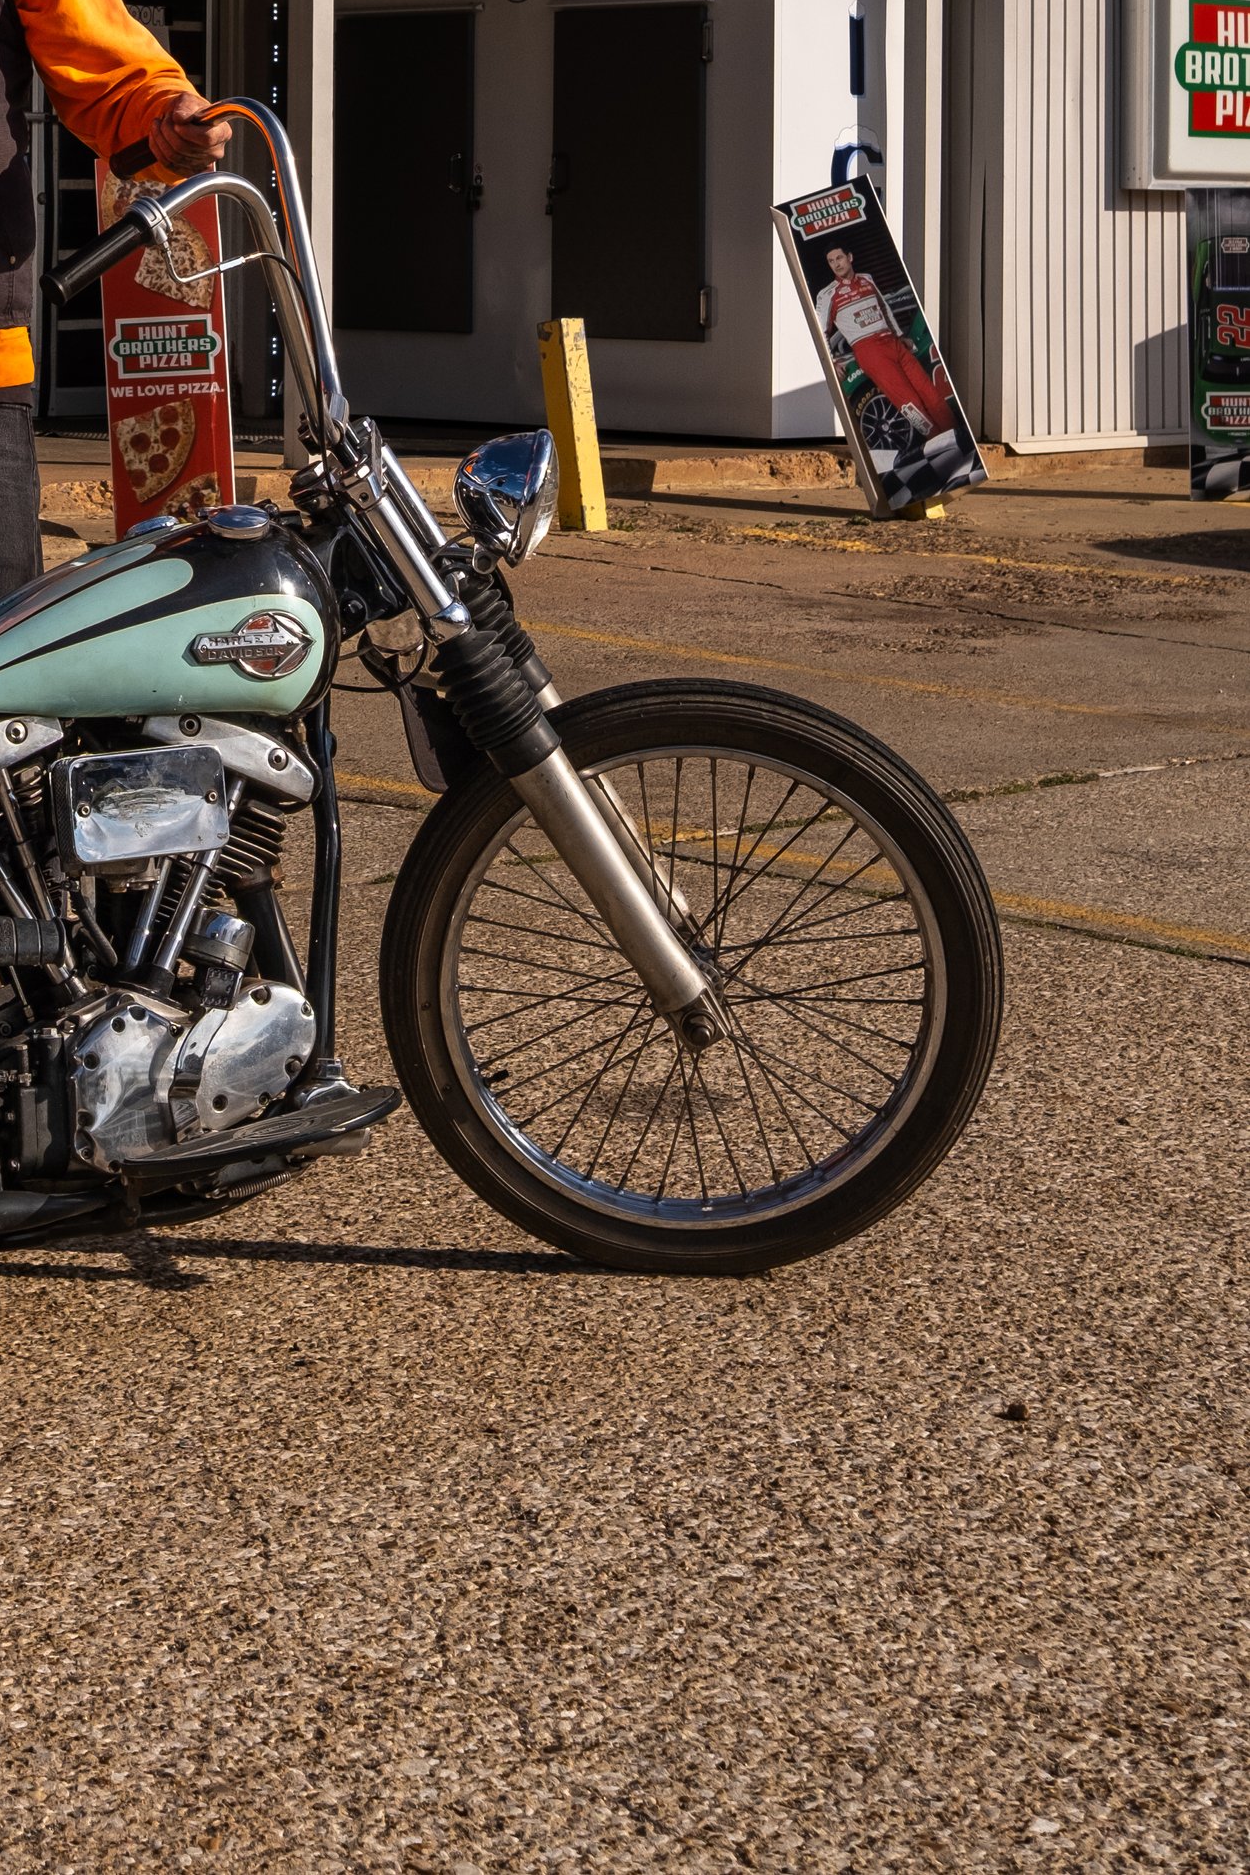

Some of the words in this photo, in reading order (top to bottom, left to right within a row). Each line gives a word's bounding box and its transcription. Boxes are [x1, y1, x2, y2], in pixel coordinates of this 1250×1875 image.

[806, 192, 841, 213] HUNT
[797, 198, 859, 226] BROTHERS
[813, 210, 850, 230] PIZZA
[138, 324, 189, 340] HUNT
[119, 338, 211, 355] BROTHERS
[139, 353, 192, 369] PIZZA
[111, 386, 134, 397] WE
[137, 384, 175, 397] LOVE
[178, 381, 225, 394] PIZZA.
[208, 646, 285, 660] DAVIDSON
